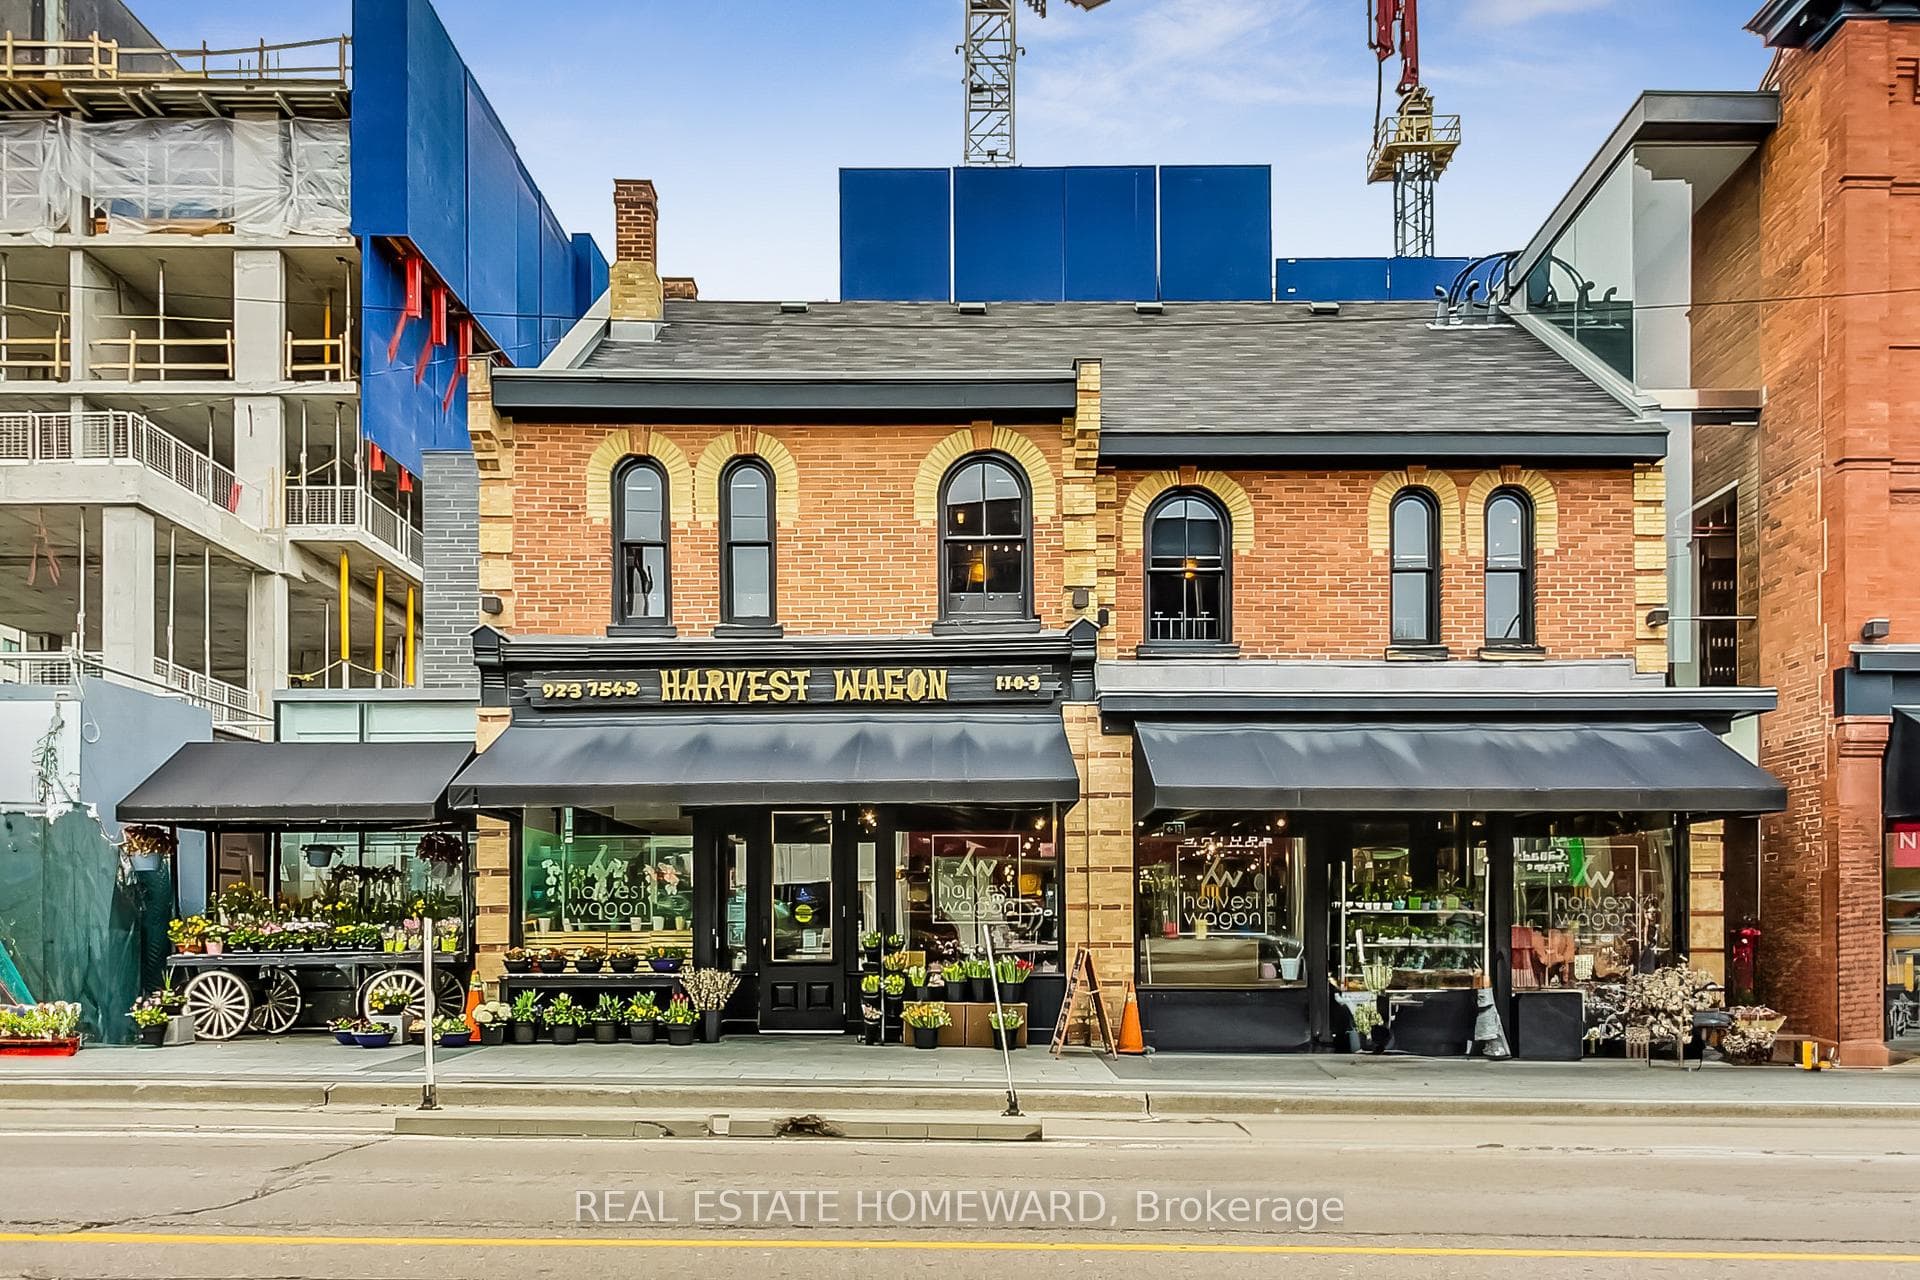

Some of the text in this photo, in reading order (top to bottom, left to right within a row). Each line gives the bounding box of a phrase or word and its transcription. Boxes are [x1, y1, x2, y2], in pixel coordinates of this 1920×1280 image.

[542, 681, 641, 699] 923 7542
[659, 669, 948, 702] HARVEST WAGON
[568, 881, 646, 900] havest
[1183, 891, 1259, 910] harvest
[568, 902, 647, 920] wagon
[1183, 911, 1261, 930] wagon
